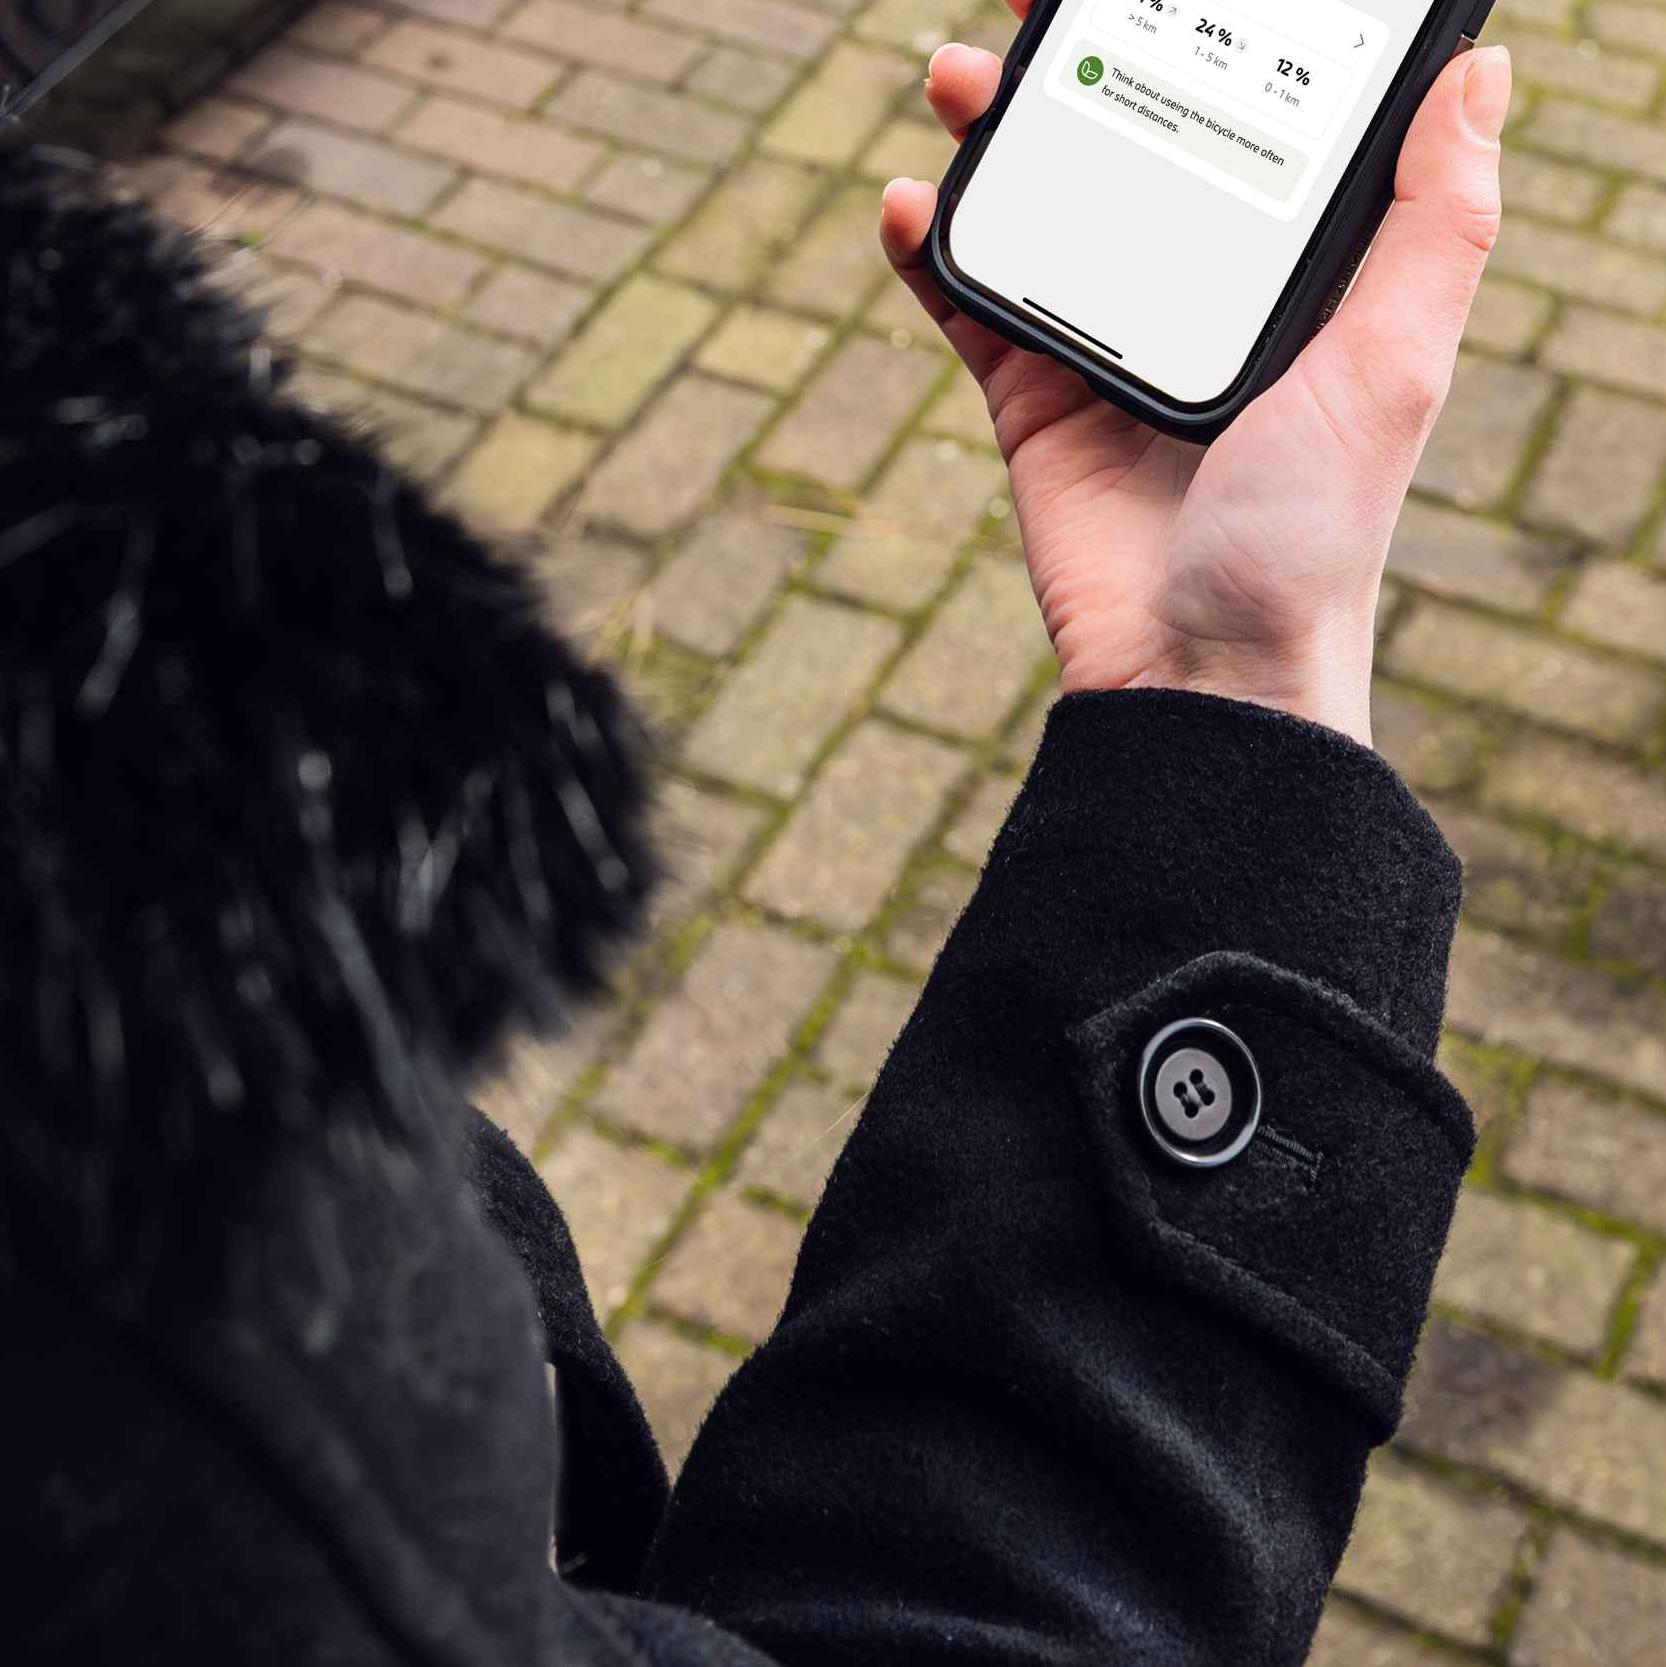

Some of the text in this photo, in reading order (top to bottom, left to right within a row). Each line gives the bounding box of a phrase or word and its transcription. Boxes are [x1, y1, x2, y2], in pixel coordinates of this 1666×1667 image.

[1135, 16, 1144, 26] 5
[1142, 20, 1157, 34] km
[1195, 18, 1232, 47] 24 %
[1194, 46, 1201, 55] 1
[1205, 52, 1214, 62] 5
[1213, 56, 1228, 70] km
[1276, 58, 1310, 86] 12 %
[1101, 84, 1179, 133] for short distances.
[1264, 82, 1273, 93] 0
[1279, 89, 1285, 99] 1
[1284, 92, 1300, 107] km
[1112, 67, 1285, 166] Think about useing the bicycle more often
